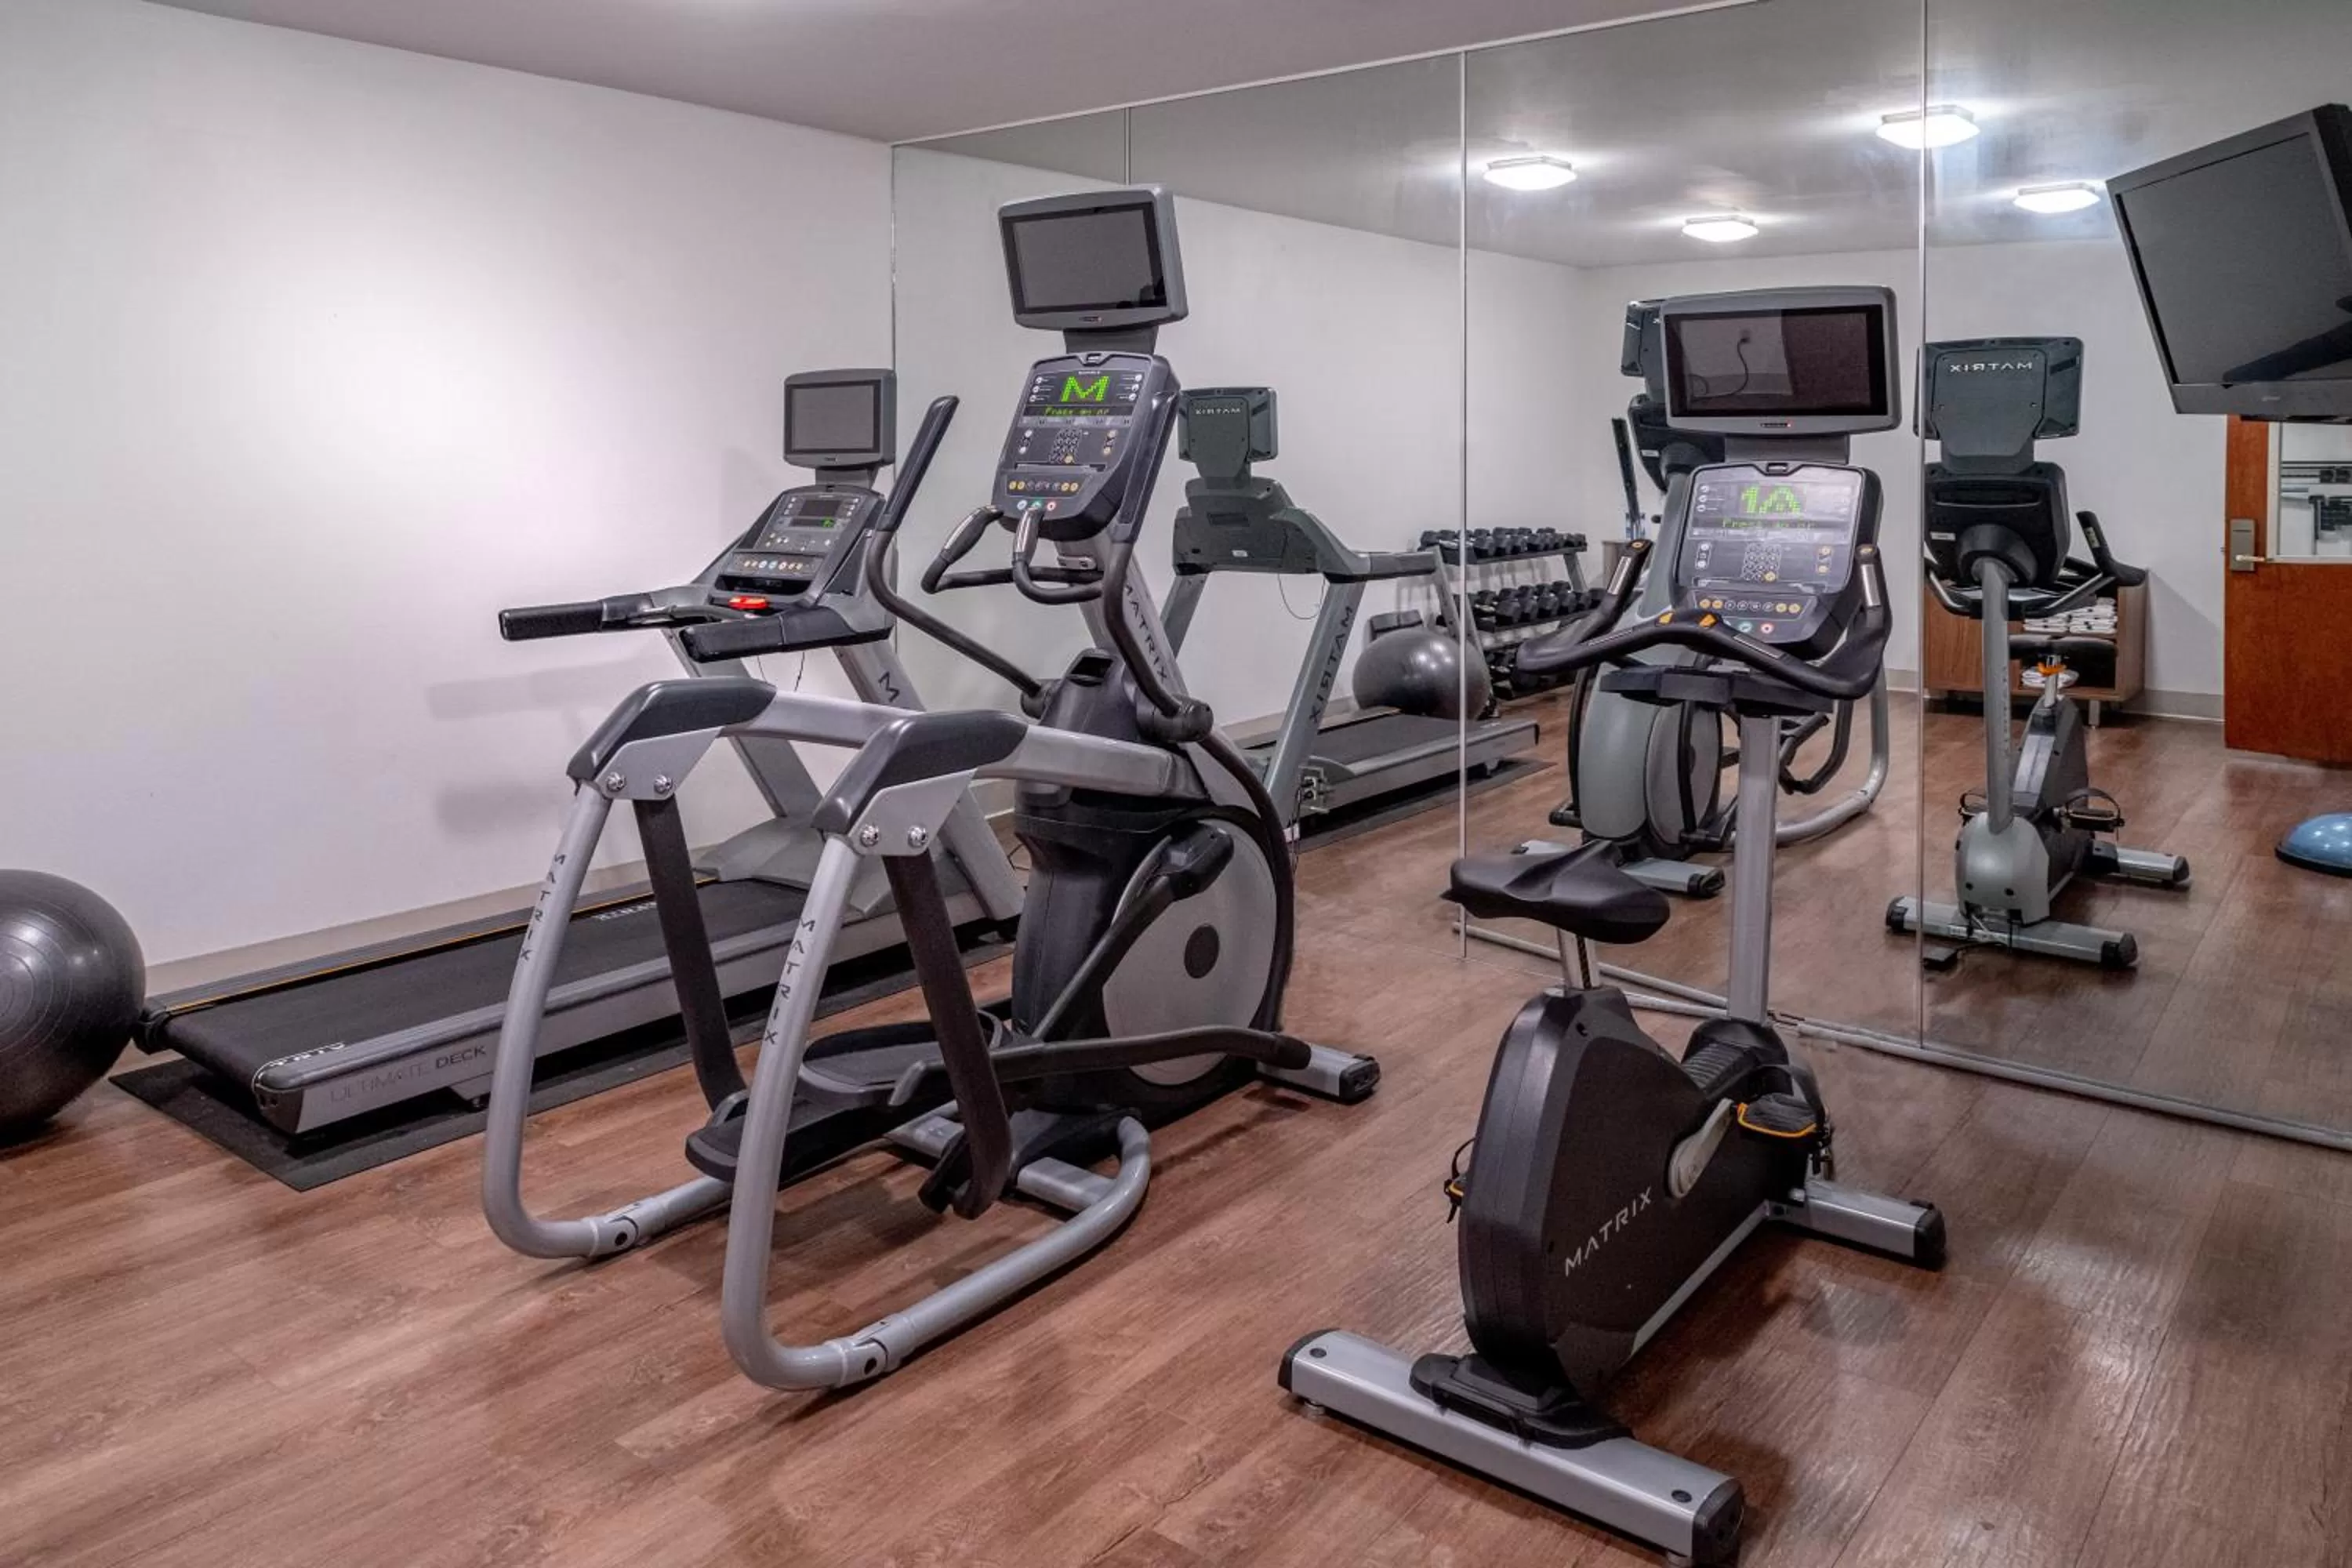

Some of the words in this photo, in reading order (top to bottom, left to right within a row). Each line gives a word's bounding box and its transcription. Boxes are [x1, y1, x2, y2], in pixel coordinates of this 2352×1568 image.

[1061, 375, 1111, 402] M
[521, 853, 568, 961] MATRIX
[764, 917, 816, 1045] MATRIX
[435, 1044, 488, 1069] DECK
[1565, 1185, 1652, 1277] MATRIX
